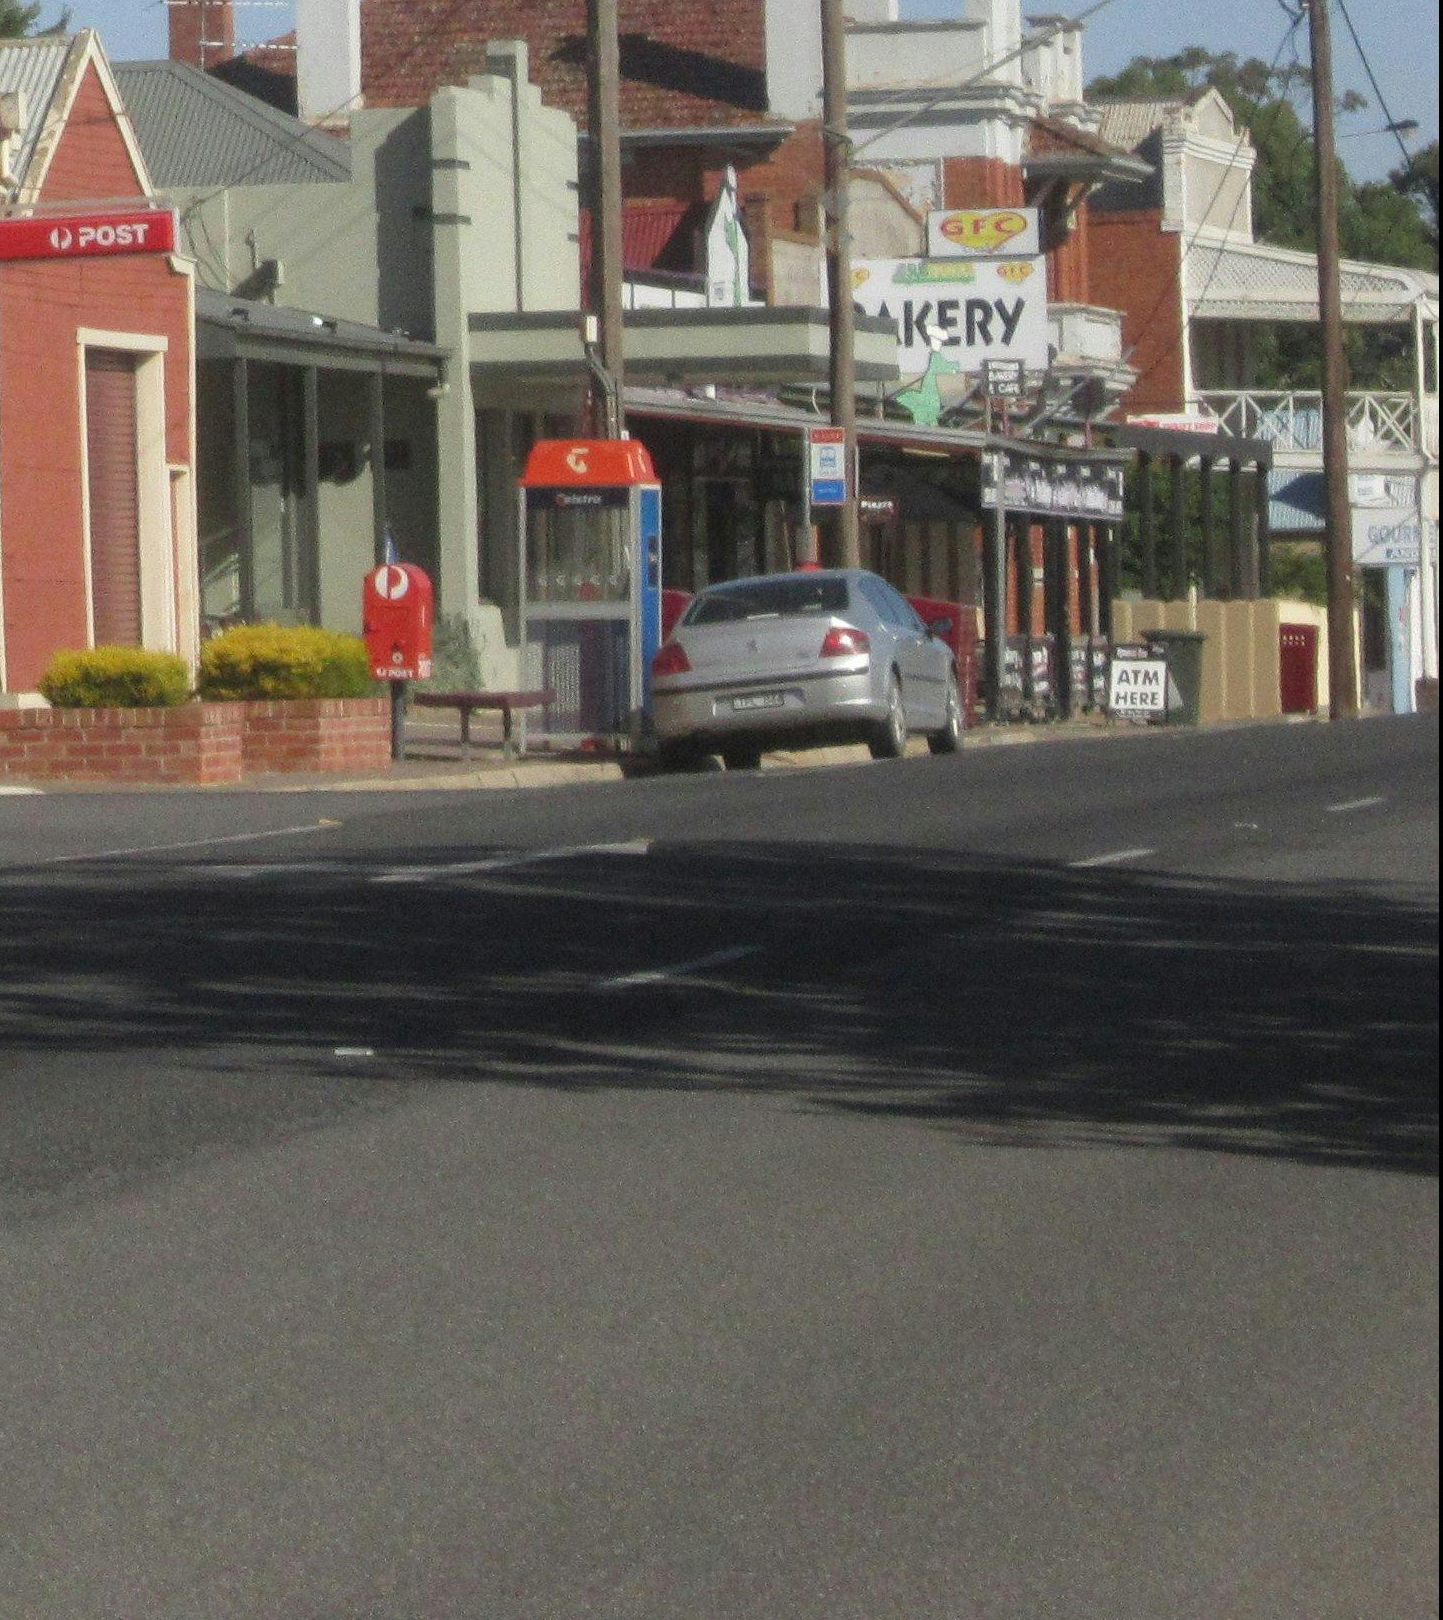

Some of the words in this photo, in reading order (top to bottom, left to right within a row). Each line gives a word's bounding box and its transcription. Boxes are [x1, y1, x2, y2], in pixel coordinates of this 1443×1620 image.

[78, 223, 149, 247] POST
[940, 218, 1013, 237] GFC
[854, 298, 1026, 347] KERY
[1117, 669, 1159, 687] ATM
[1115, 691, 1159, 706] HERE
